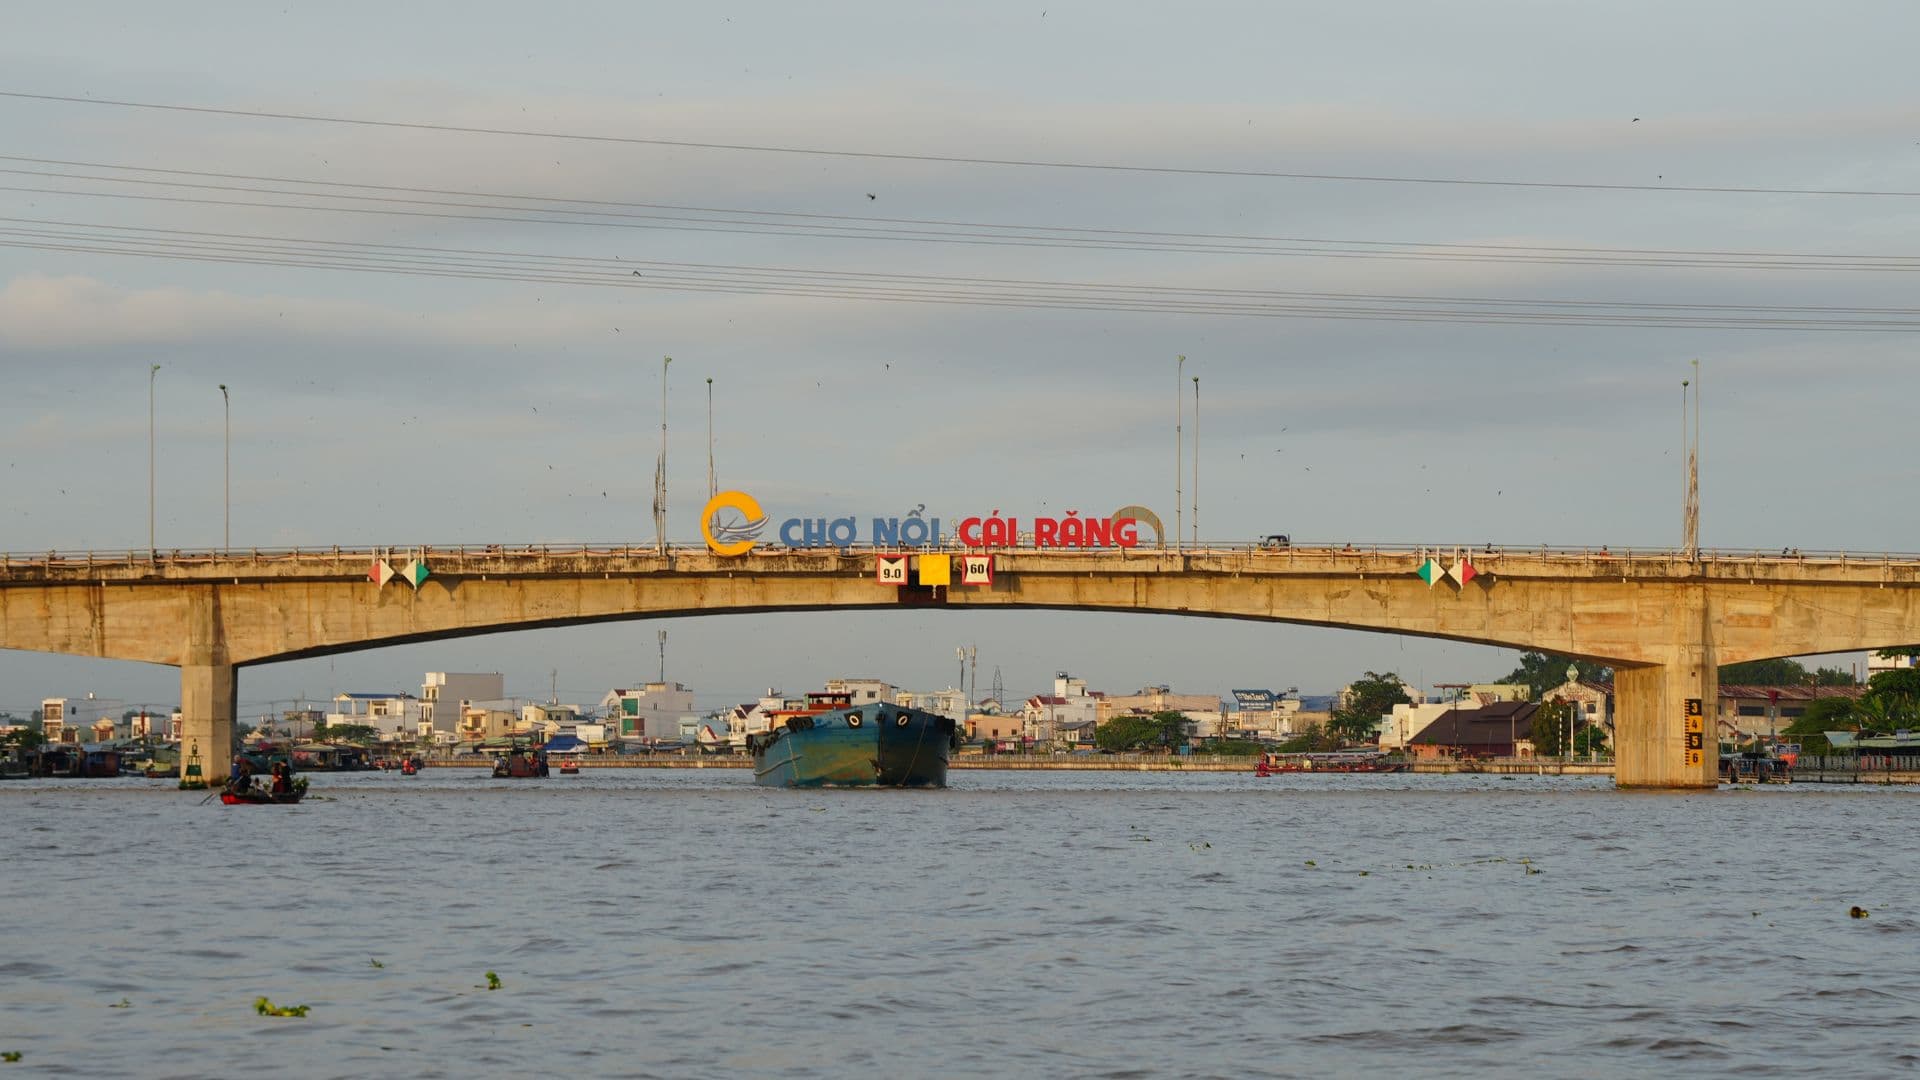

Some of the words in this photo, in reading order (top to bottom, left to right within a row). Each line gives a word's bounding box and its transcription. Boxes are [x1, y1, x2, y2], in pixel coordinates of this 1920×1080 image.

[780, 516, 858, 556] CHỢ
[873, 503, 940, 547] NỔI
[958, 509, 1017, 548] CÁI
[1034, 510, 1138, 549] RĂNG
[883, 568, 903, 580] 9.0
[970, 563, 985, 575] 60
[1691, 702, 1698, 713] 3
[1691, 719, 1698, 729] 4
[1692, 735, 1699, 746] 5
[1692, 752, 1699, 764] 6
